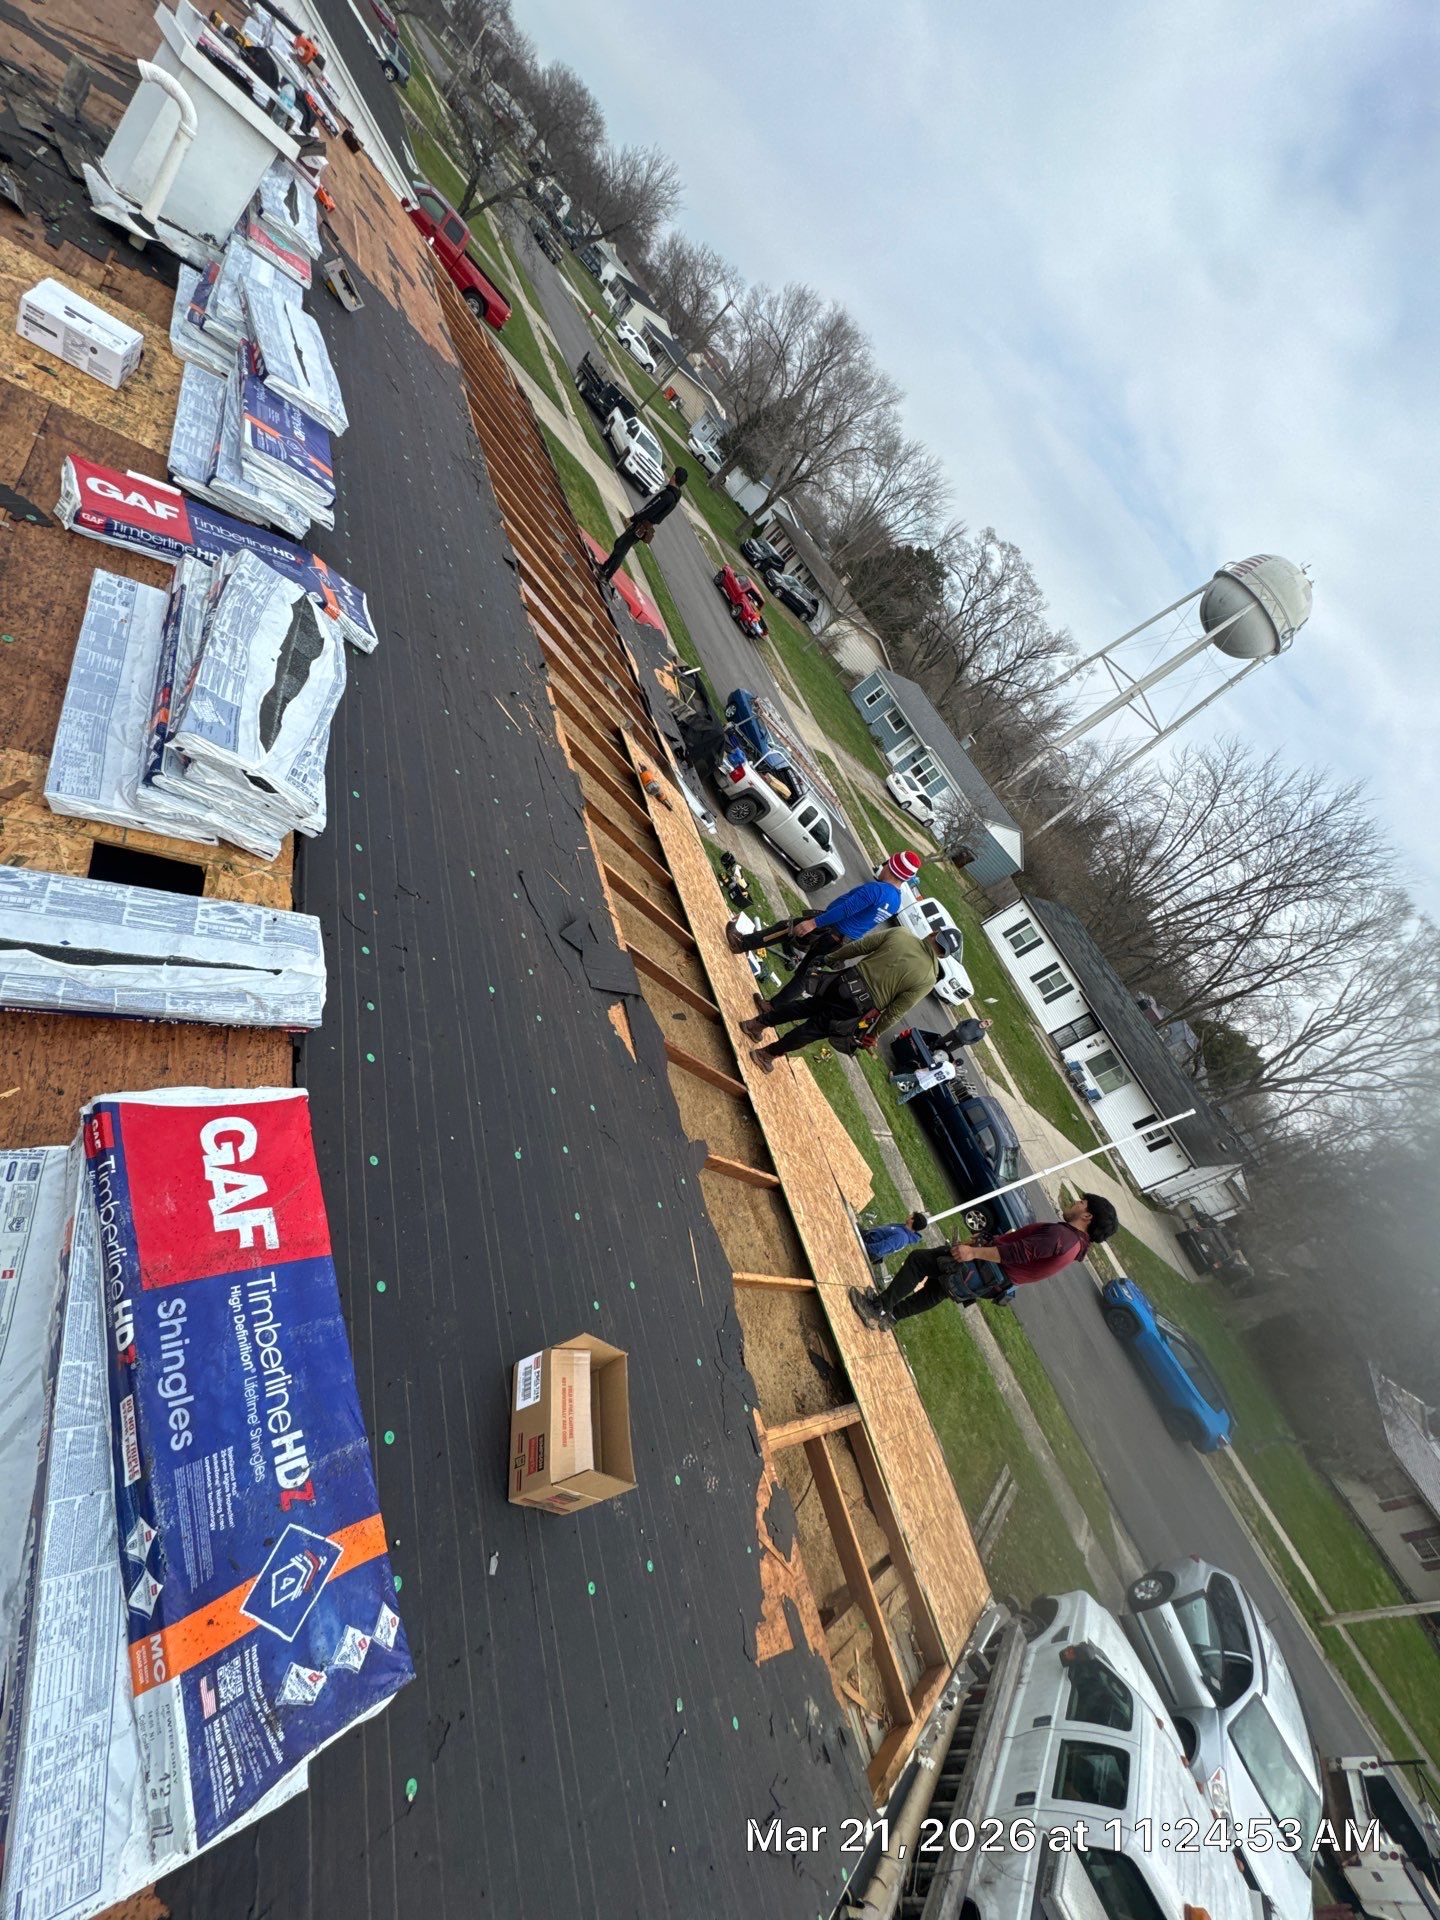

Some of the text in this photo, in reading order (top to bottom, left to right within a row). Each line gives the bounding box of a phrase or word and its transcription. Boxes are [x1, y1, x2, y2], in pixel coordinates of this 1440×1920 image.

[81, 512, 105, 525] GAF
[86, 477, 180, 520] GAF
[91, 1118, 102, 1149] GAF
[200, 1116, 280, 1250] GAF
[157, 1298, 195, 1451] Shingles
[228, 1285, 244, 1313] High
[249, 1427, 267, 1483] Shingles
[126, 1399, 132, 1413] DO
[130, 1440, 140, 1477] TRIPLE
[207, 1490, 216, 1531] Technology
[150, 1633, 166, 1683] MC
[165, 1703, 174, 1749] PEWTER
[213, 1718, 223, 1747] MADE
[218, 1745, 227, 1757] IN
[220, 1756, 231, 1777] THE
